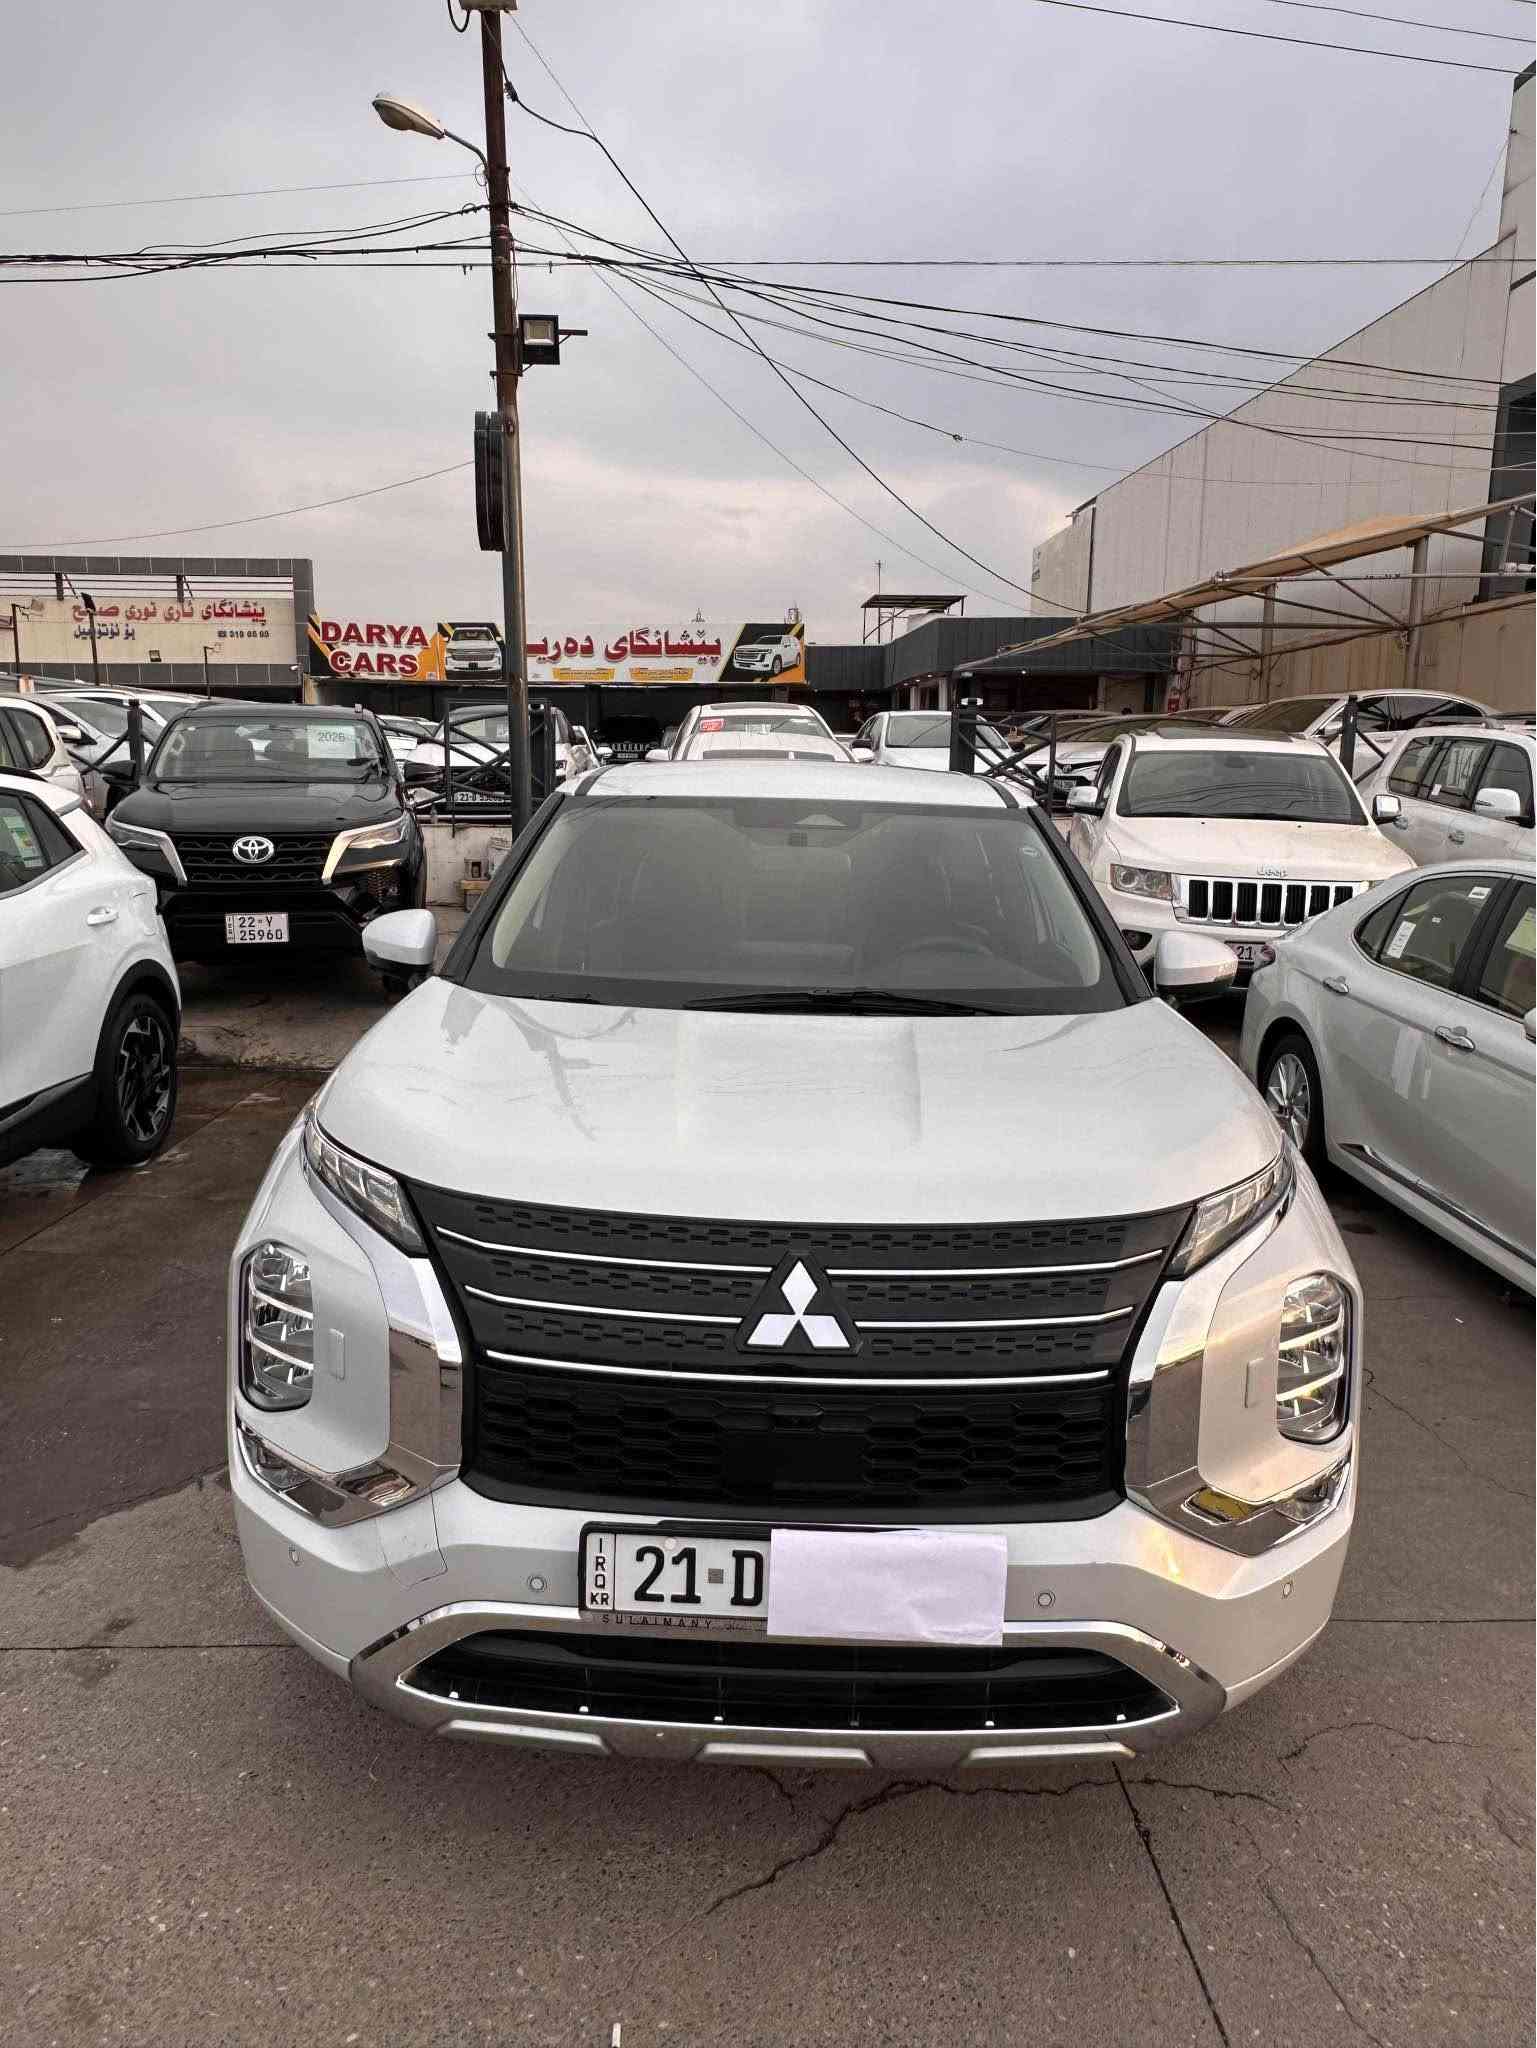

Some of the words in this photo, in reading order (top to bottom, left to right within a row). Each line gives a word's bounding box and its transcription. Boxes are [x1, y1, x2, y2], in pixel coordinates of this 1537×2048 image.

[320, 621, 429, 647] DARYA
[605, 627, 722, 666] پێشانگای
[527, 635, 595, 664] دەری
[330, 650, 419, 676] CARS
[238, 916, 256, 928] 22
[239, 928, 283, 941] 25960
[1236, 945, 1254, 960] 21
[634, 1545, 702, 1604] 21
[730, 1549, 764, 1607] D
